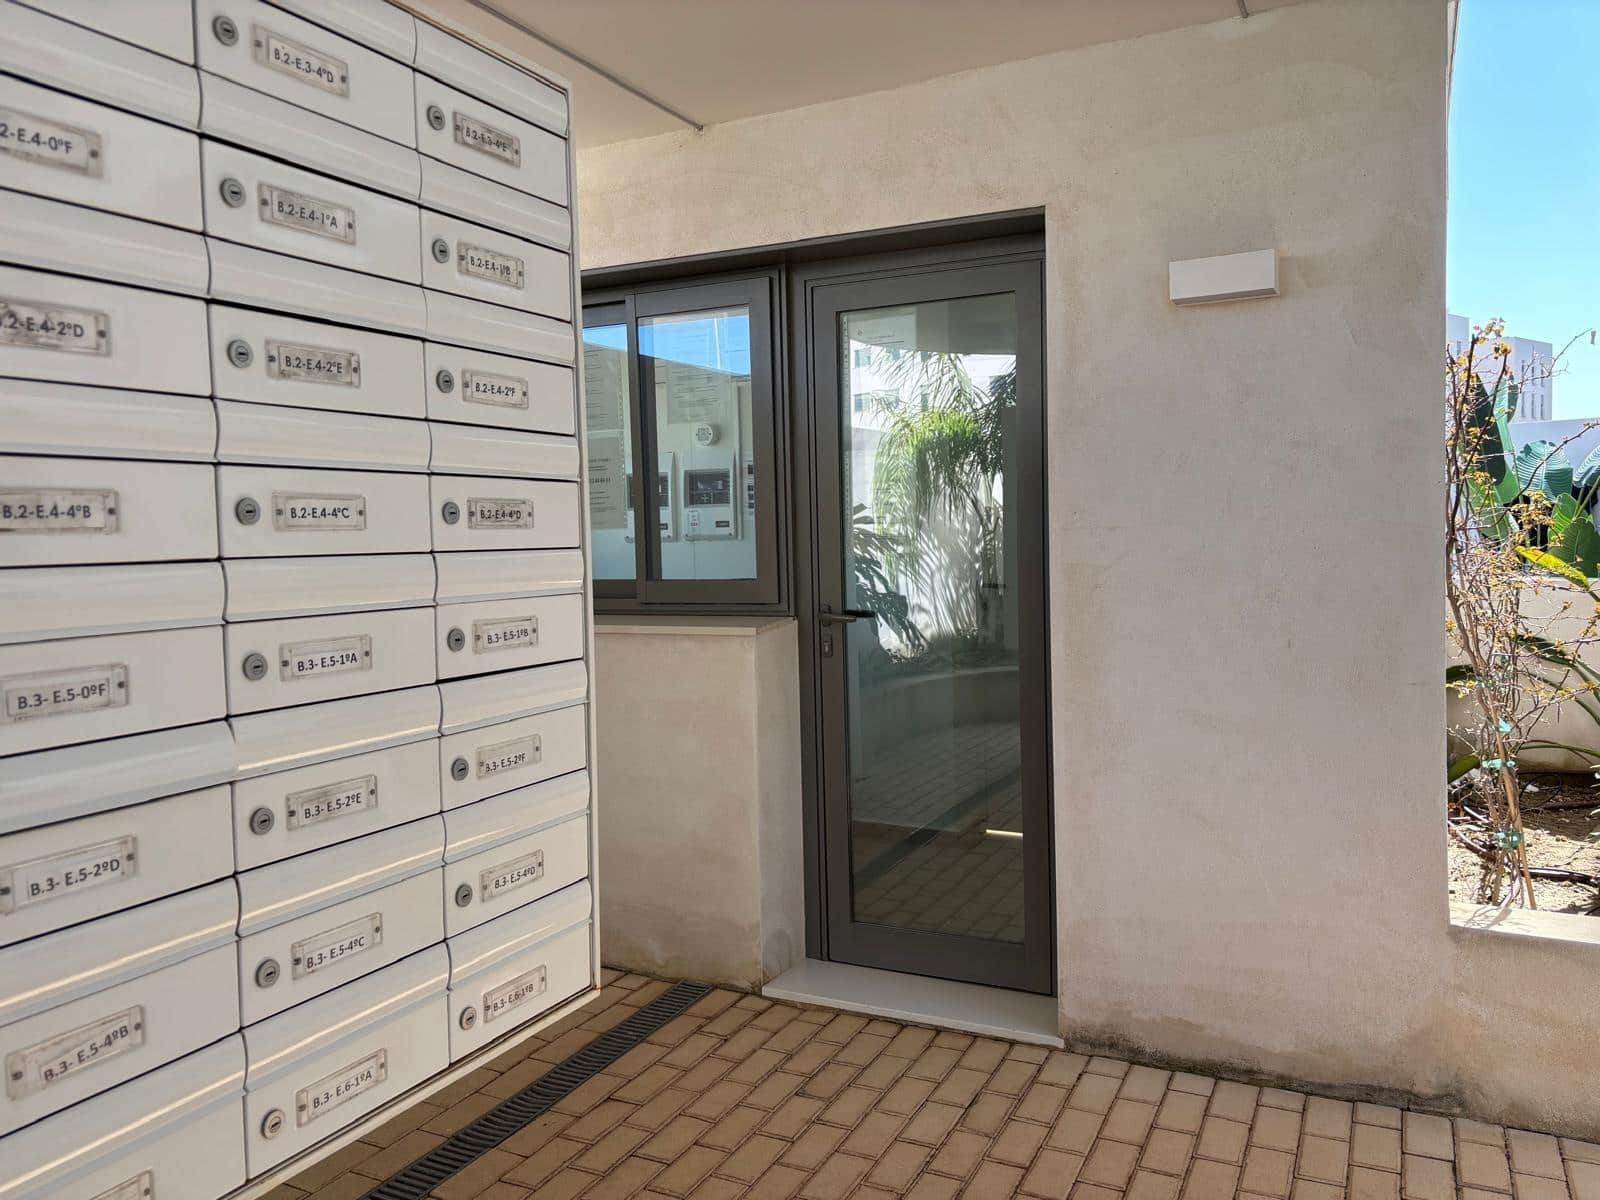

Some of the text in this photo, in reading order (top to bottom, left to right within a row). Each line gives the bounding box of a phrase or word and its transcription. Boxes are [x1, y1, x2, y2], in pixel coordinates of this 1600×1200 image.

[297, 658, 319, 672] B.3-
[17, 692, 49, 710] B.3-
[304, 804, 324, 819] B.3-
[30, 876, 60, 896] B.3-
[306, 951, 327, 969] B.3-
[44, 1061, 73, 1082] B.3-
[313, 1092, 333, 1109] B.3-
